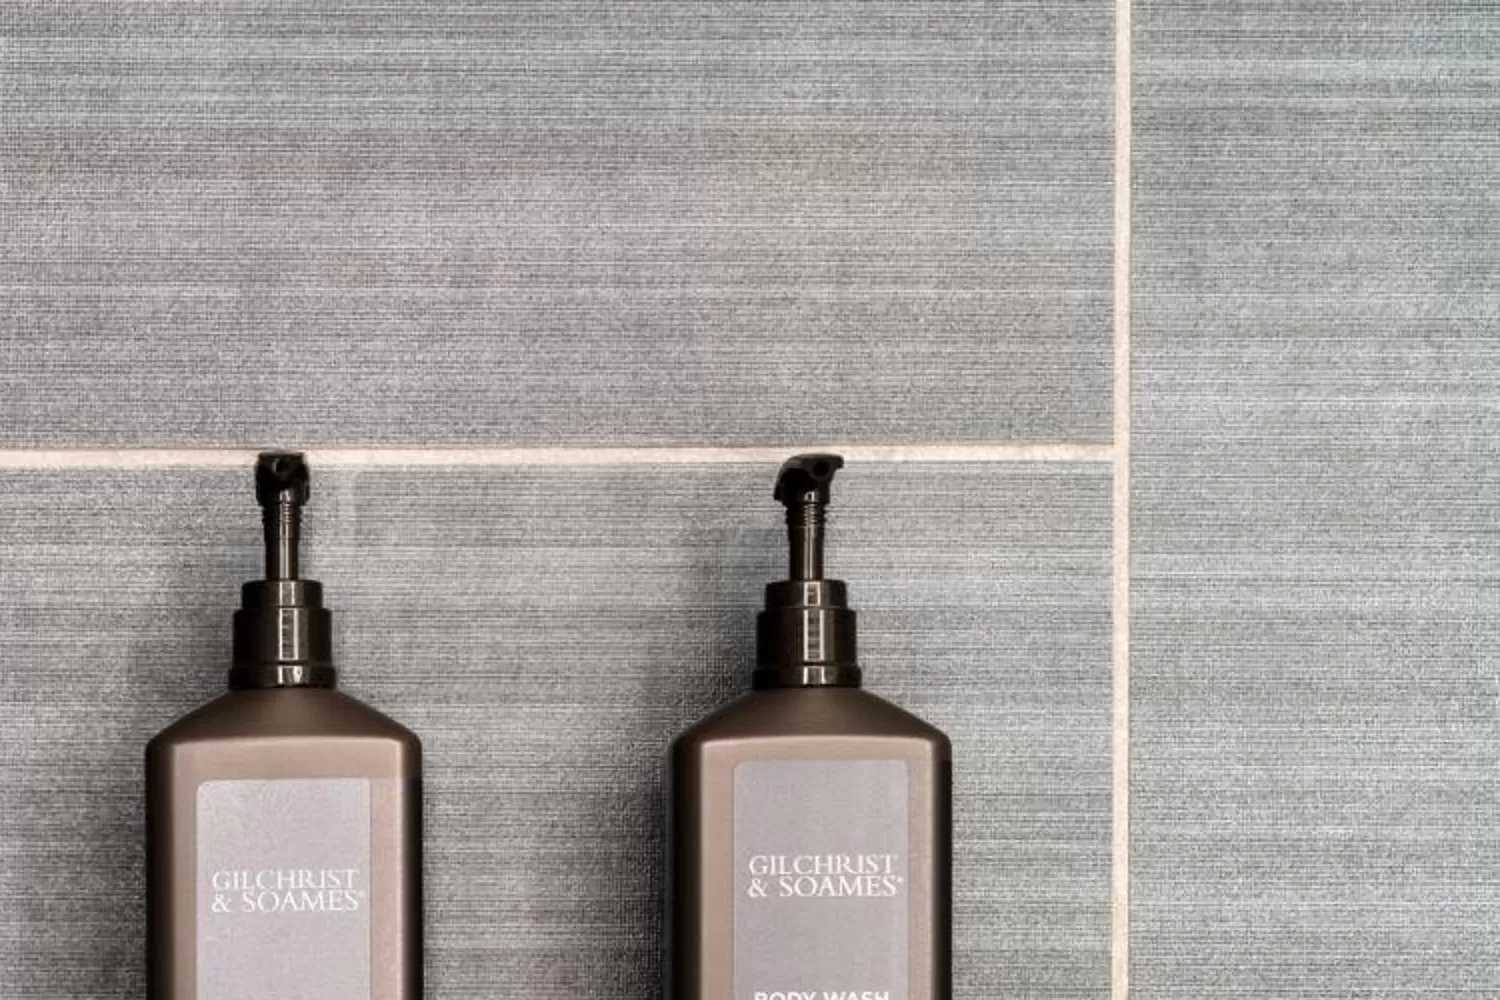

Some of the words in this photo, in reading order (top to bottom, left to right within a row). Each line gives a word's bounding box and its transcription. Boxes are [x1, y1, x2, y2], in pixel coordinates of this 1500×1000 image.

[748, 854, 899, 875] GILCHRIST
[212, 868, 360, 890] GILCHRIST
[747, 878, 768, 897] &
[211, 891, 232, 913] &
